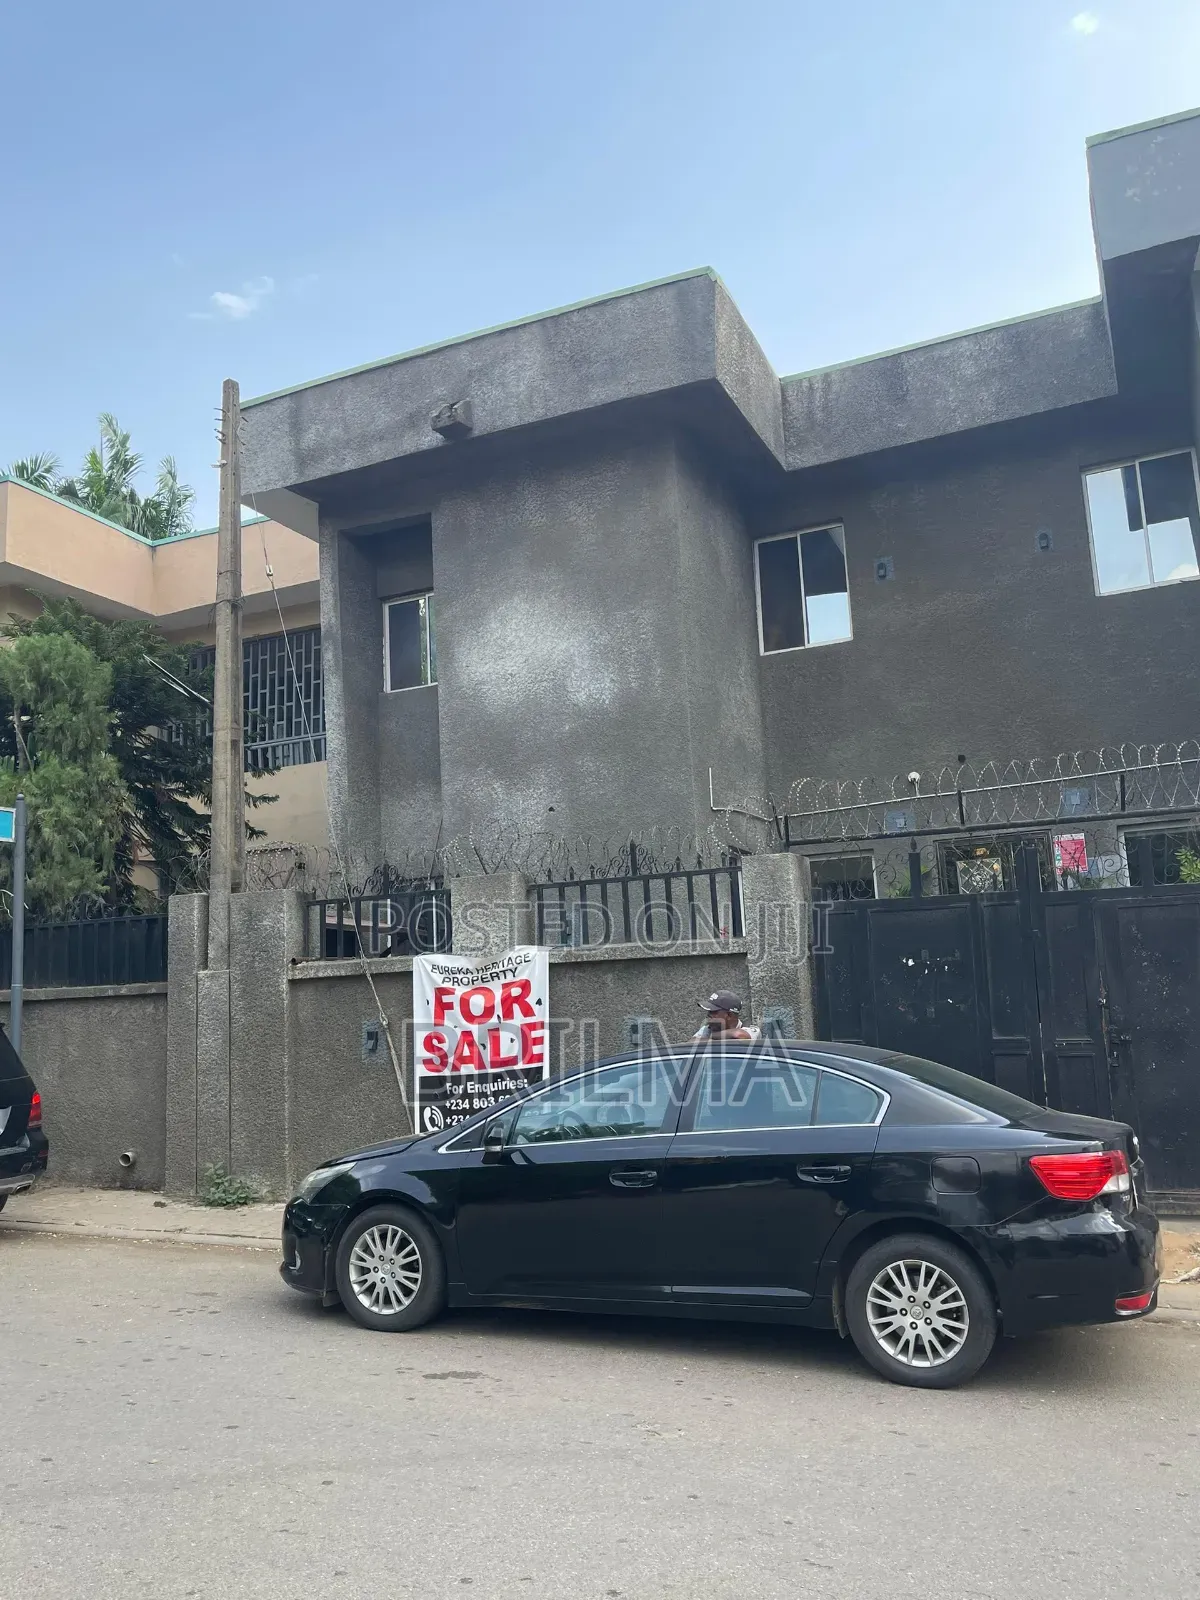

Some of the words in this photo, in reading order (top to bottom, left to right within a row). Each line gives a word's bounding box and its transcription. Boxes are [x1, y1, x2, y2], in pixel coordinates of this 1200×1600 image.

[431, 964, 473, 976] EUREKA
[475, 953, 531, 975] HERITAGE
[441, 966, 518, 987] PROPERTY
[433, 978, 536, 1028] FOR
[422, 1020, 545, 1074] SALE
[446, 1082, 464, 1095] For
[467, 1078, 528, 1095] Enquiries:
[445, 1098, 470, 1110] +234
